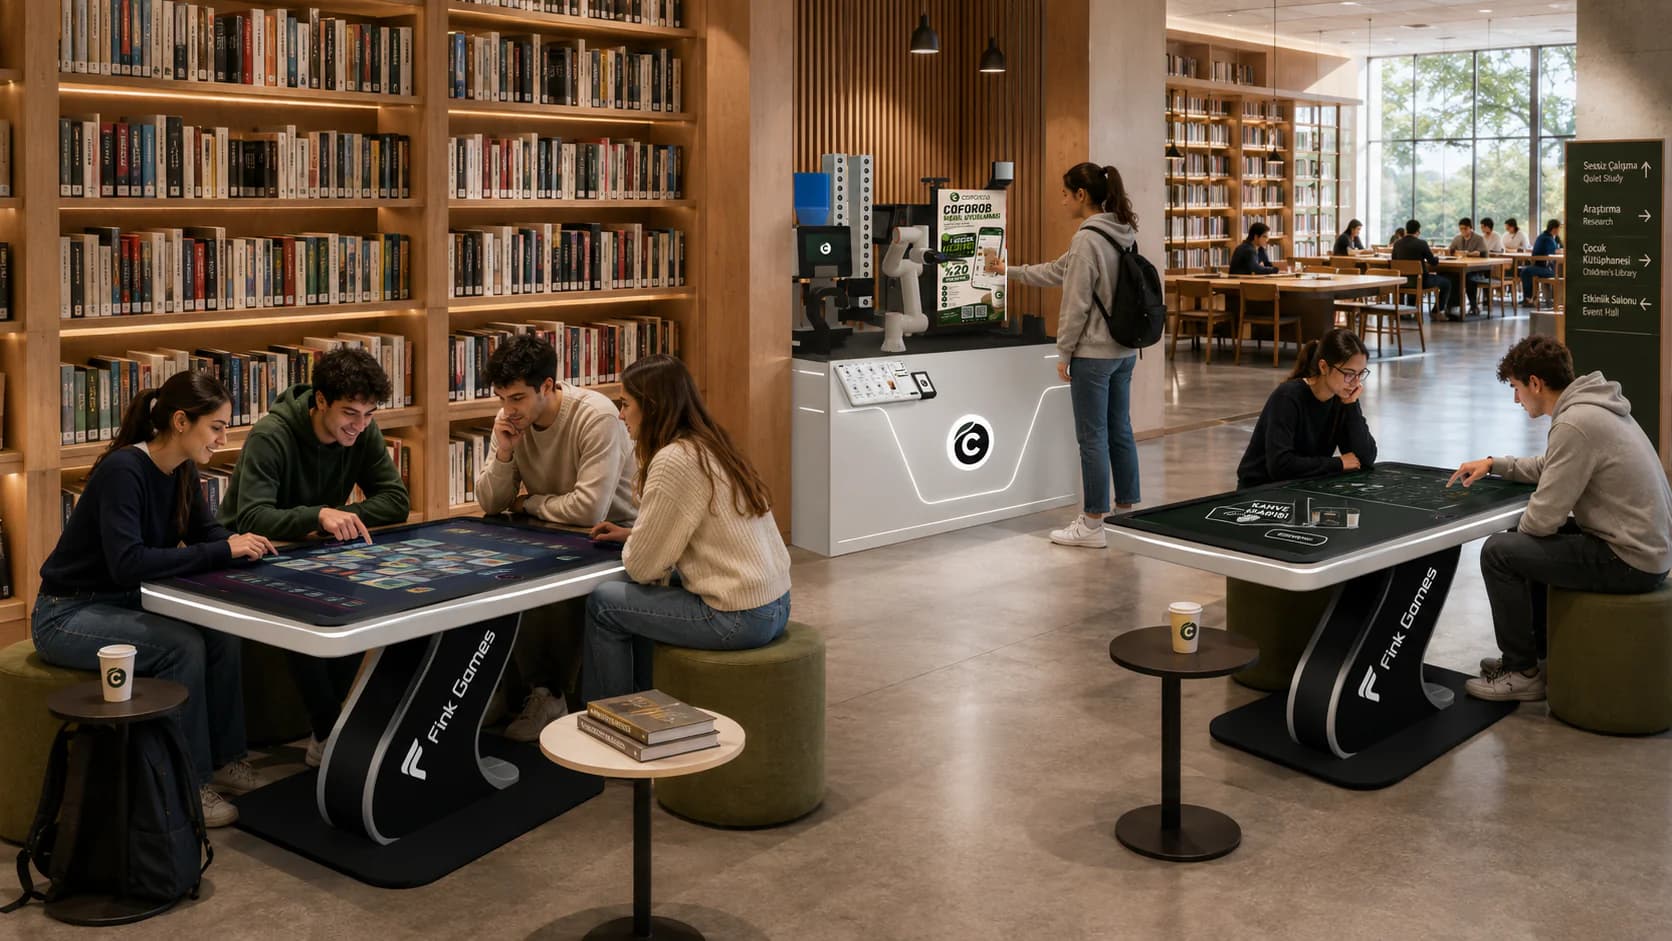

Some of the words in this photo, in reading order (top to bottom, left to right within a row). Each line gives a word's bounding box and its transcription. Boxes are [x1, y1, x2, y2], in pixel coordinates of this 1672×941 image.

[1583, 174, 1602, 184] Quiet
[1603, 174, 1624, 184] Study
[943, 203, 992, 215] COFOROB
[1583, 204, 1621, 216] Araştırma
[1582, 217, 1614, 226] Research
[1582, 243, 1607, 254] Çocuk
[1615, 268, 1638, 279] Library
[1611, 295, 1637, 305] Salonu
[1582, 306, 1603, 317] Event
[1604, 307, 1620, 317] Hall
[1380, 631, 1406, 671] Fink
[1400, 566, 1437, 630] Games
[427, 699, 458, 744] Fink
[452, 629, 496, 698] Games
